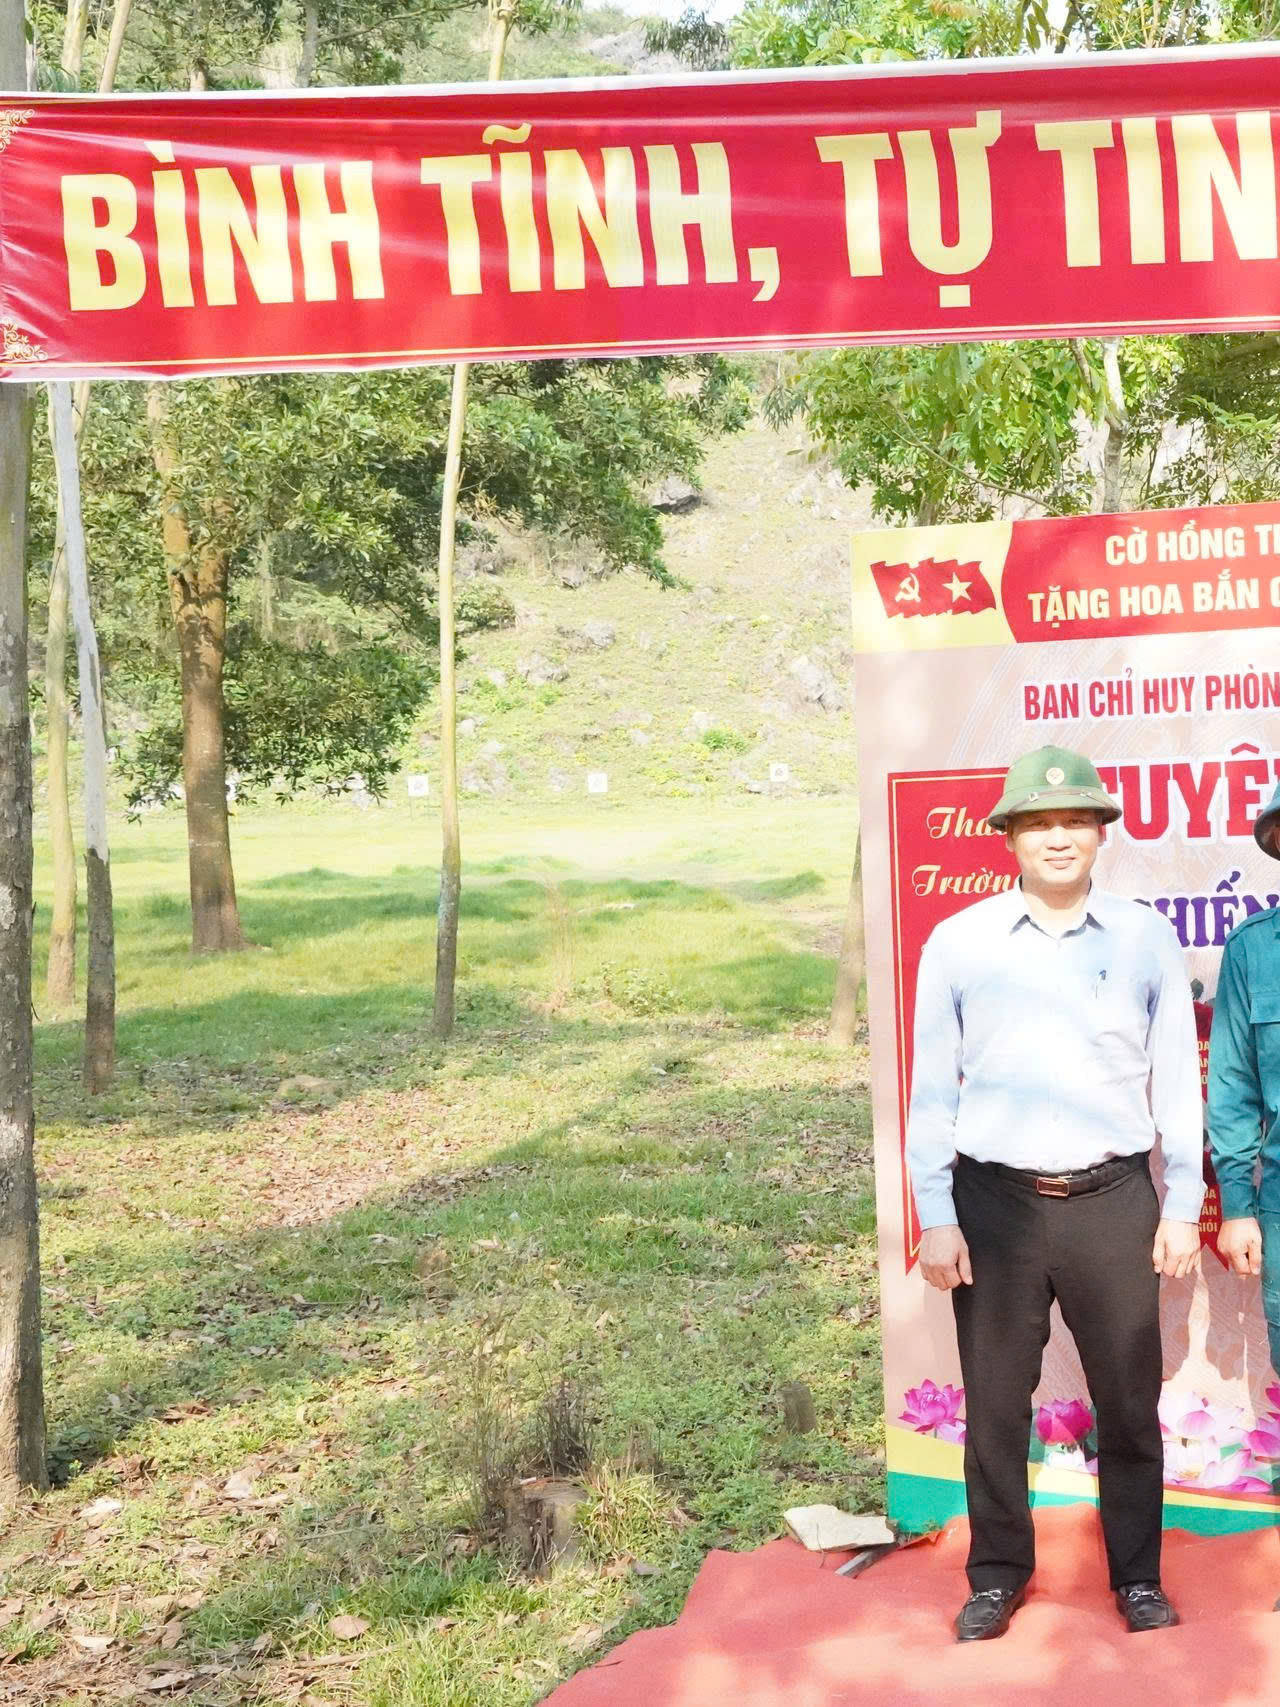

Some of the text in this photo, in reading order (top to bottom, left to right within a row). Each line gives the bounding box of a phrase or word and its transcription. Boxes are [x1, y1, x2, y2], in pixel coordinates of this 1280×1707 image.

[61, 141, 386, 311] BÌNH
[420, 123, 781, 302] TĨNH,
[815, 110, 1002, 309] TỰ
[1106, 524, 1148, 565] CỜ
[1158, 519, 1245, 561] HỒNG
[1028, 586, 1110, 629] TẶNG
[1119, 583, 1183, 617] HOA
[1192, 569, 1259, 611] BẮN
[1023, 683, 1080, 721] BAN
[1088, 667, 1134, 717] CHỈ
[1142, 676, 1195, 715] HUY
[927, 806, 1008, 839] Tha
[911, 864, 1022, 897] Trườn
